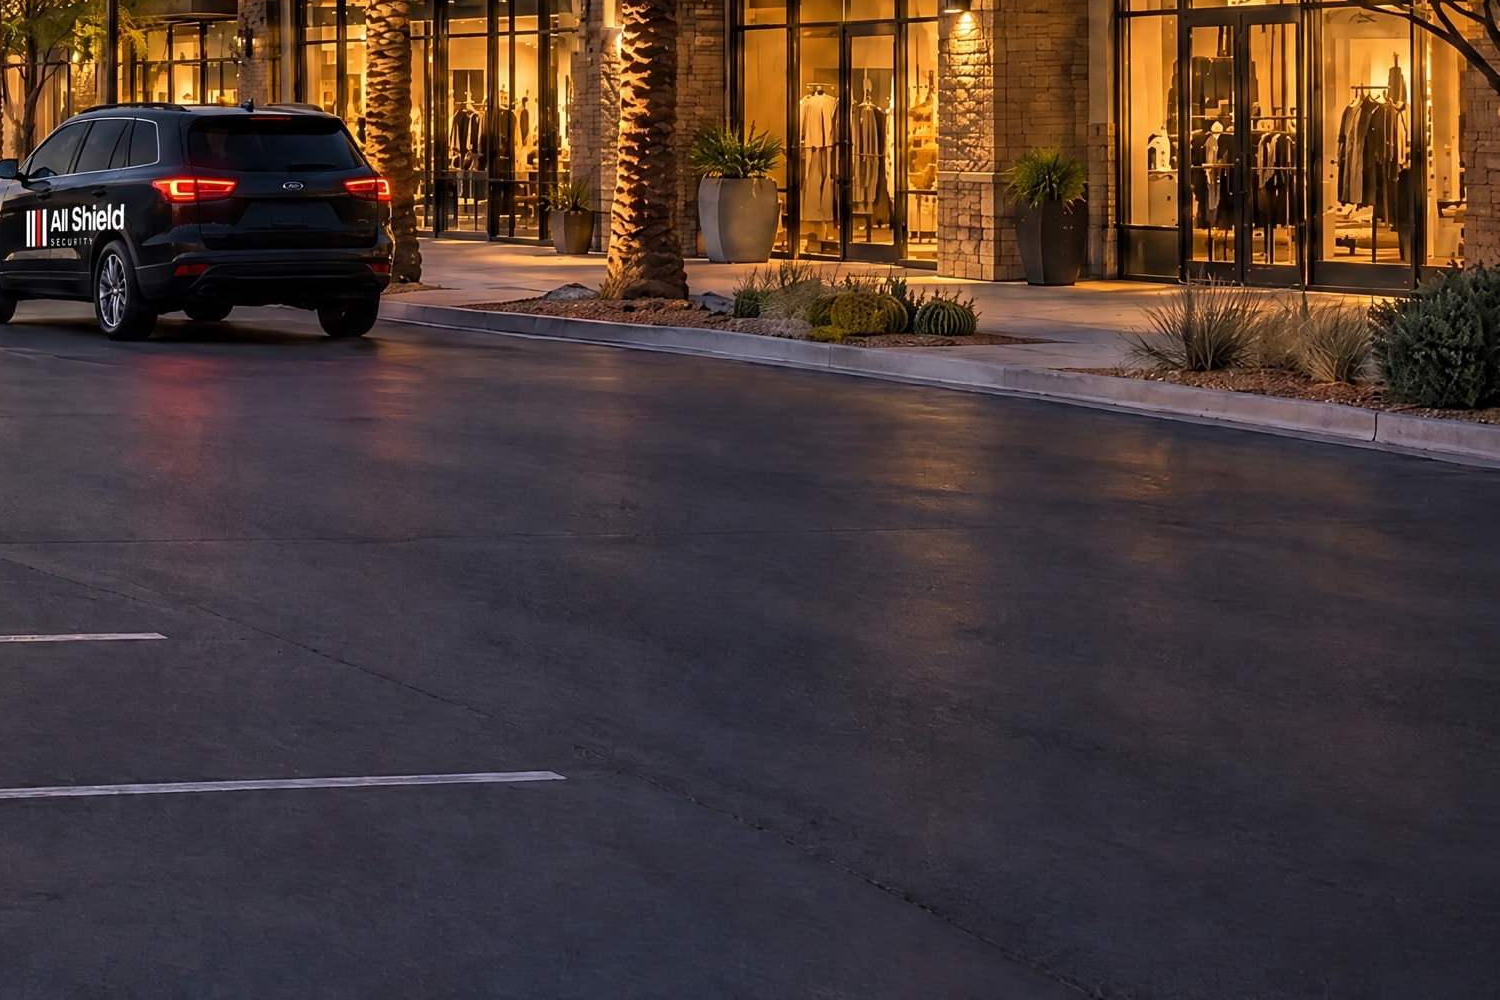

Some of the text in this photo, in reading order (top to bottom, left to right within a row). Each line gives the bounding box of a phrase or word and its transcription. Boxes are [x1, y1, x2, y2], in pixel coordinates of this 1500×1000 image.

[50, 203, 125, 232] All Shield
[50, 237, 93, 246] SECURITY
